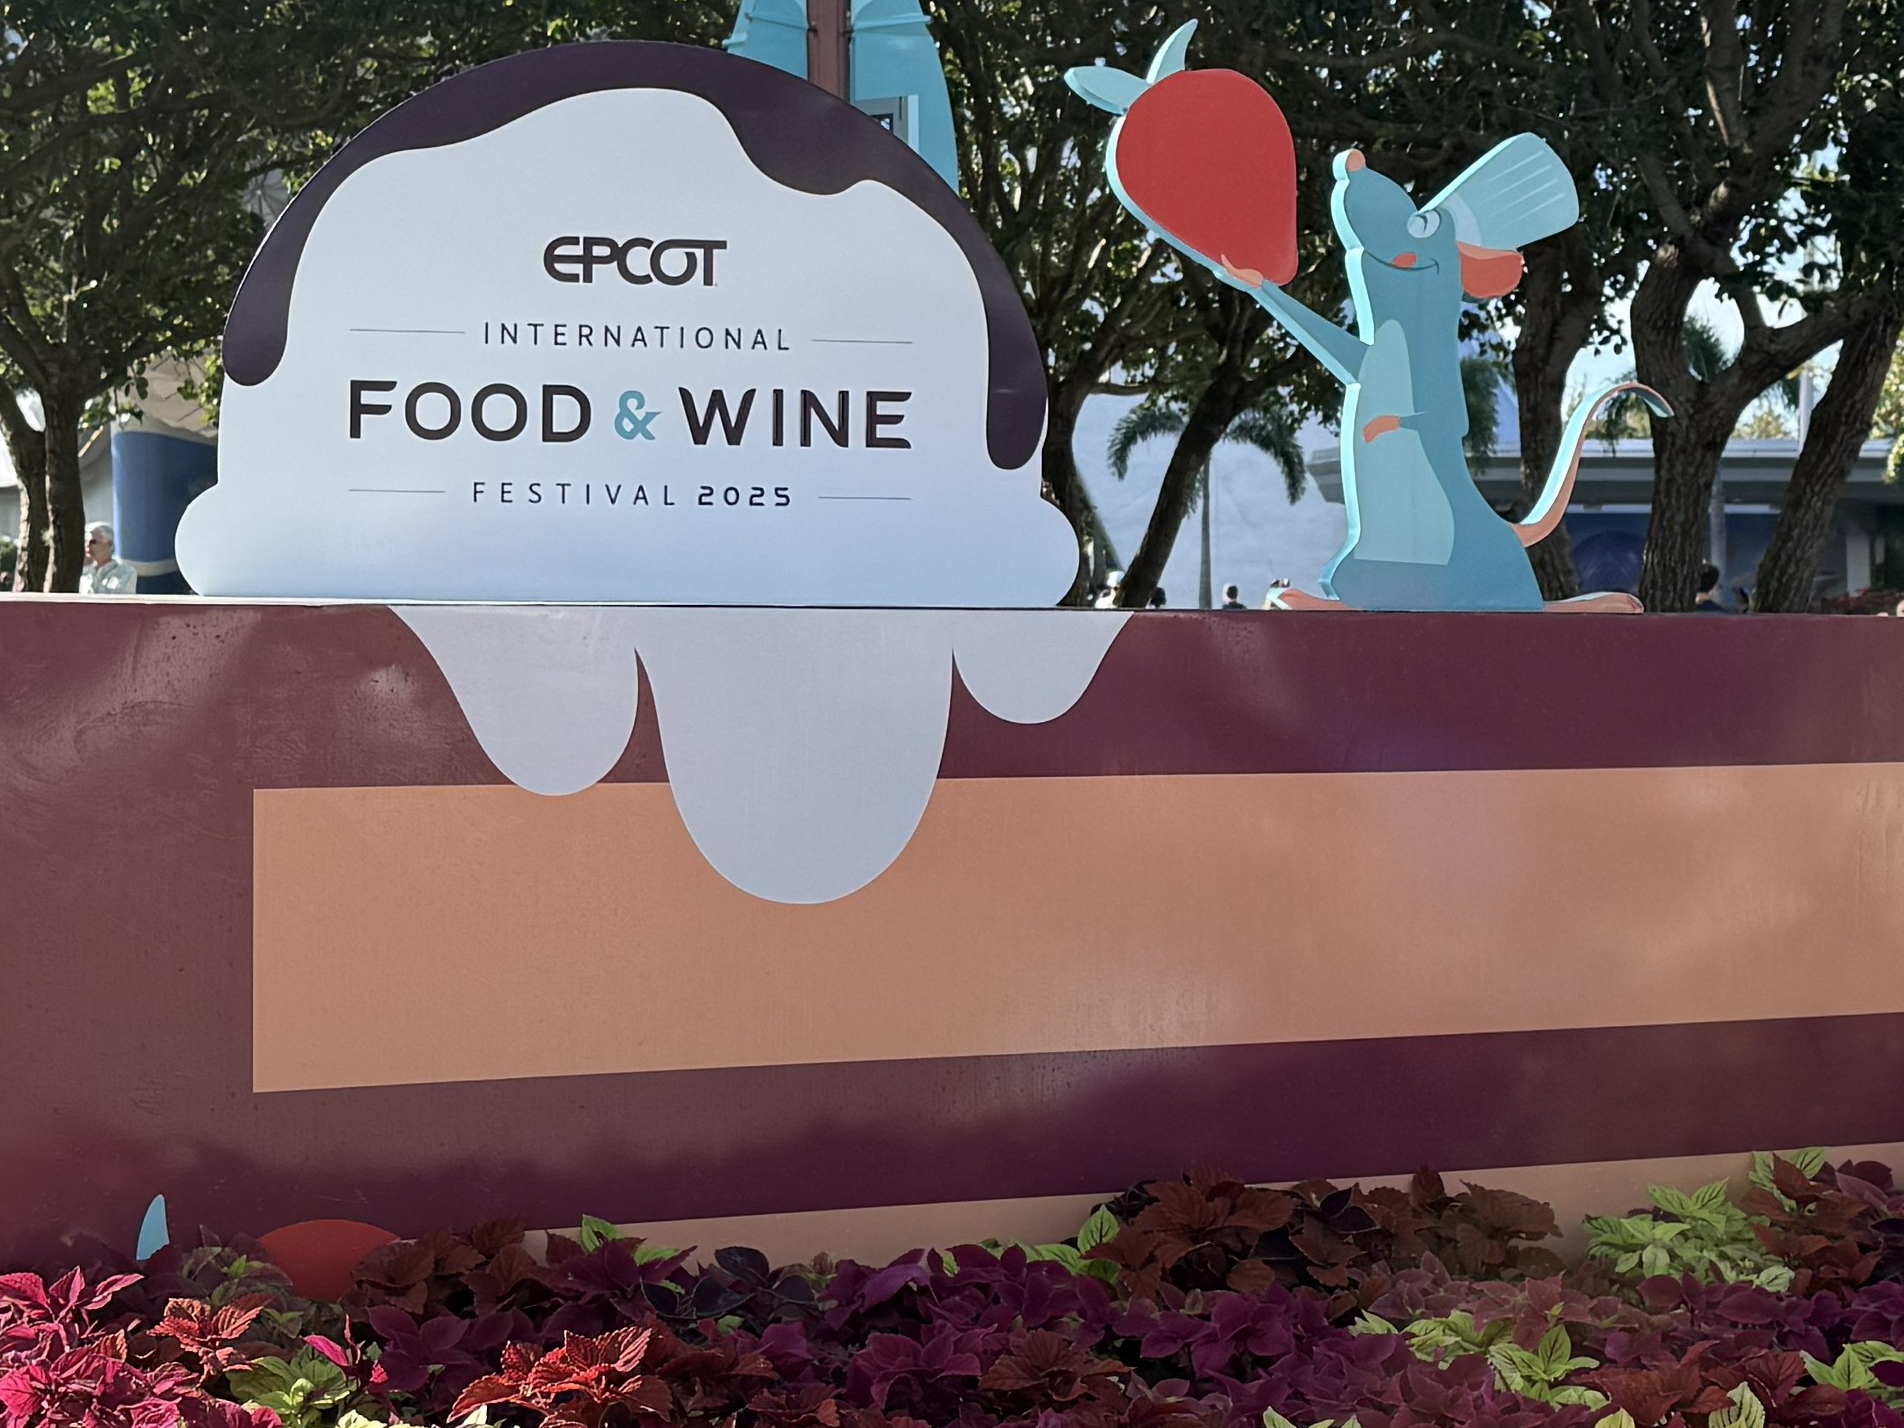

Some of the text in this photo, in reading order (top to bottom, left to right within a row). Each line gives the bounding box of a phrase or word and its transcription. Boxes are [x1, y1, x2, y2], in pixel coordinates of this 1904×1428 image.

[543, 236, 727, 286] EPCOT
[483, 322, 790, 351] INTERNATIONAL
[349, 379, 913, 450] FOOD & WINE
[473, 481, 792, 507] FESTIVAL 2025
